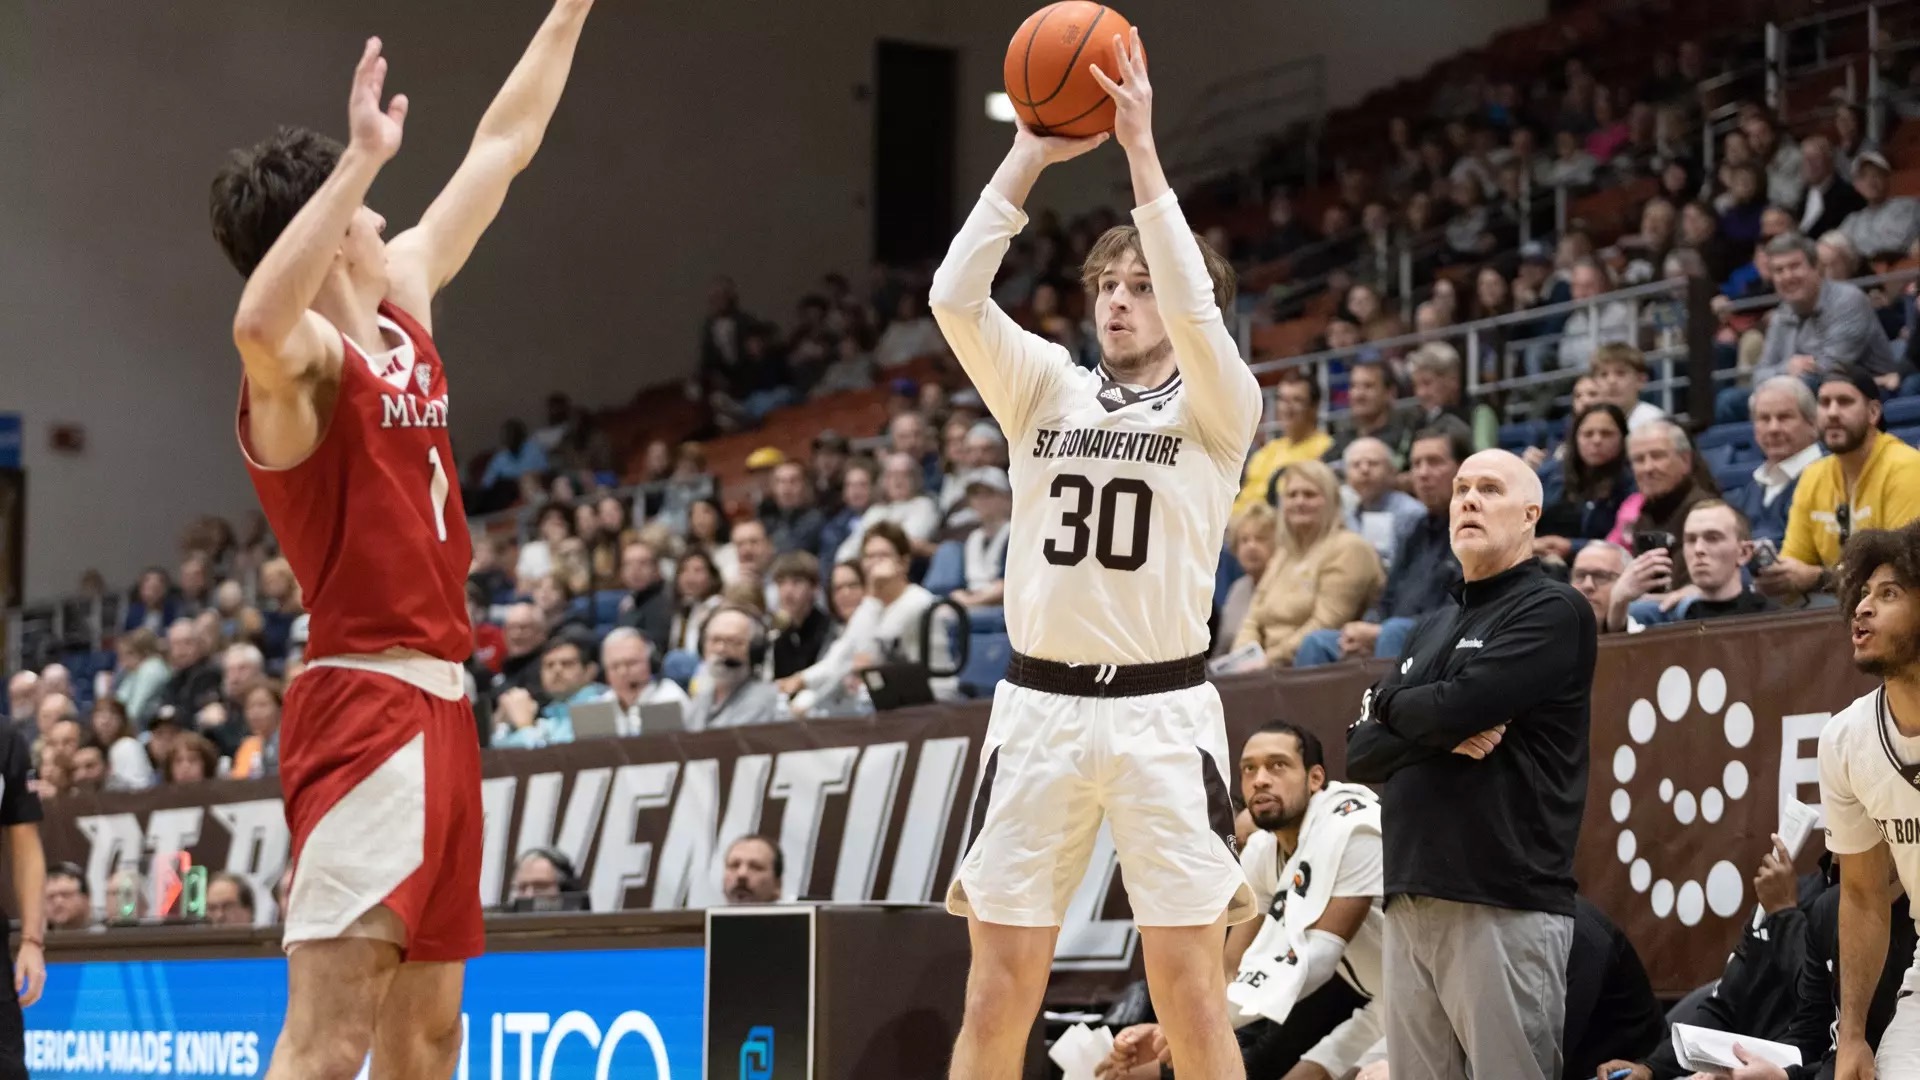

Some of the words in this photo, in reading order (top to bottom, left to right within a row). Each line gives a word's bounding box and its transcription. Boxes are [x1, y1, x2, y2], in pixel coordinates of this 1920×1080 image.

[1032, 428, 1060, 459] ST.
[1057, 428, 1183, 467] BONAVENTURE
[429, 446, 450, 542] 1
[1043, 474, 1153, 571] 30
[24, 1029, 173, 1075] ERICAN-MADE
[176, 1030, 260, 1076] KNIVES
